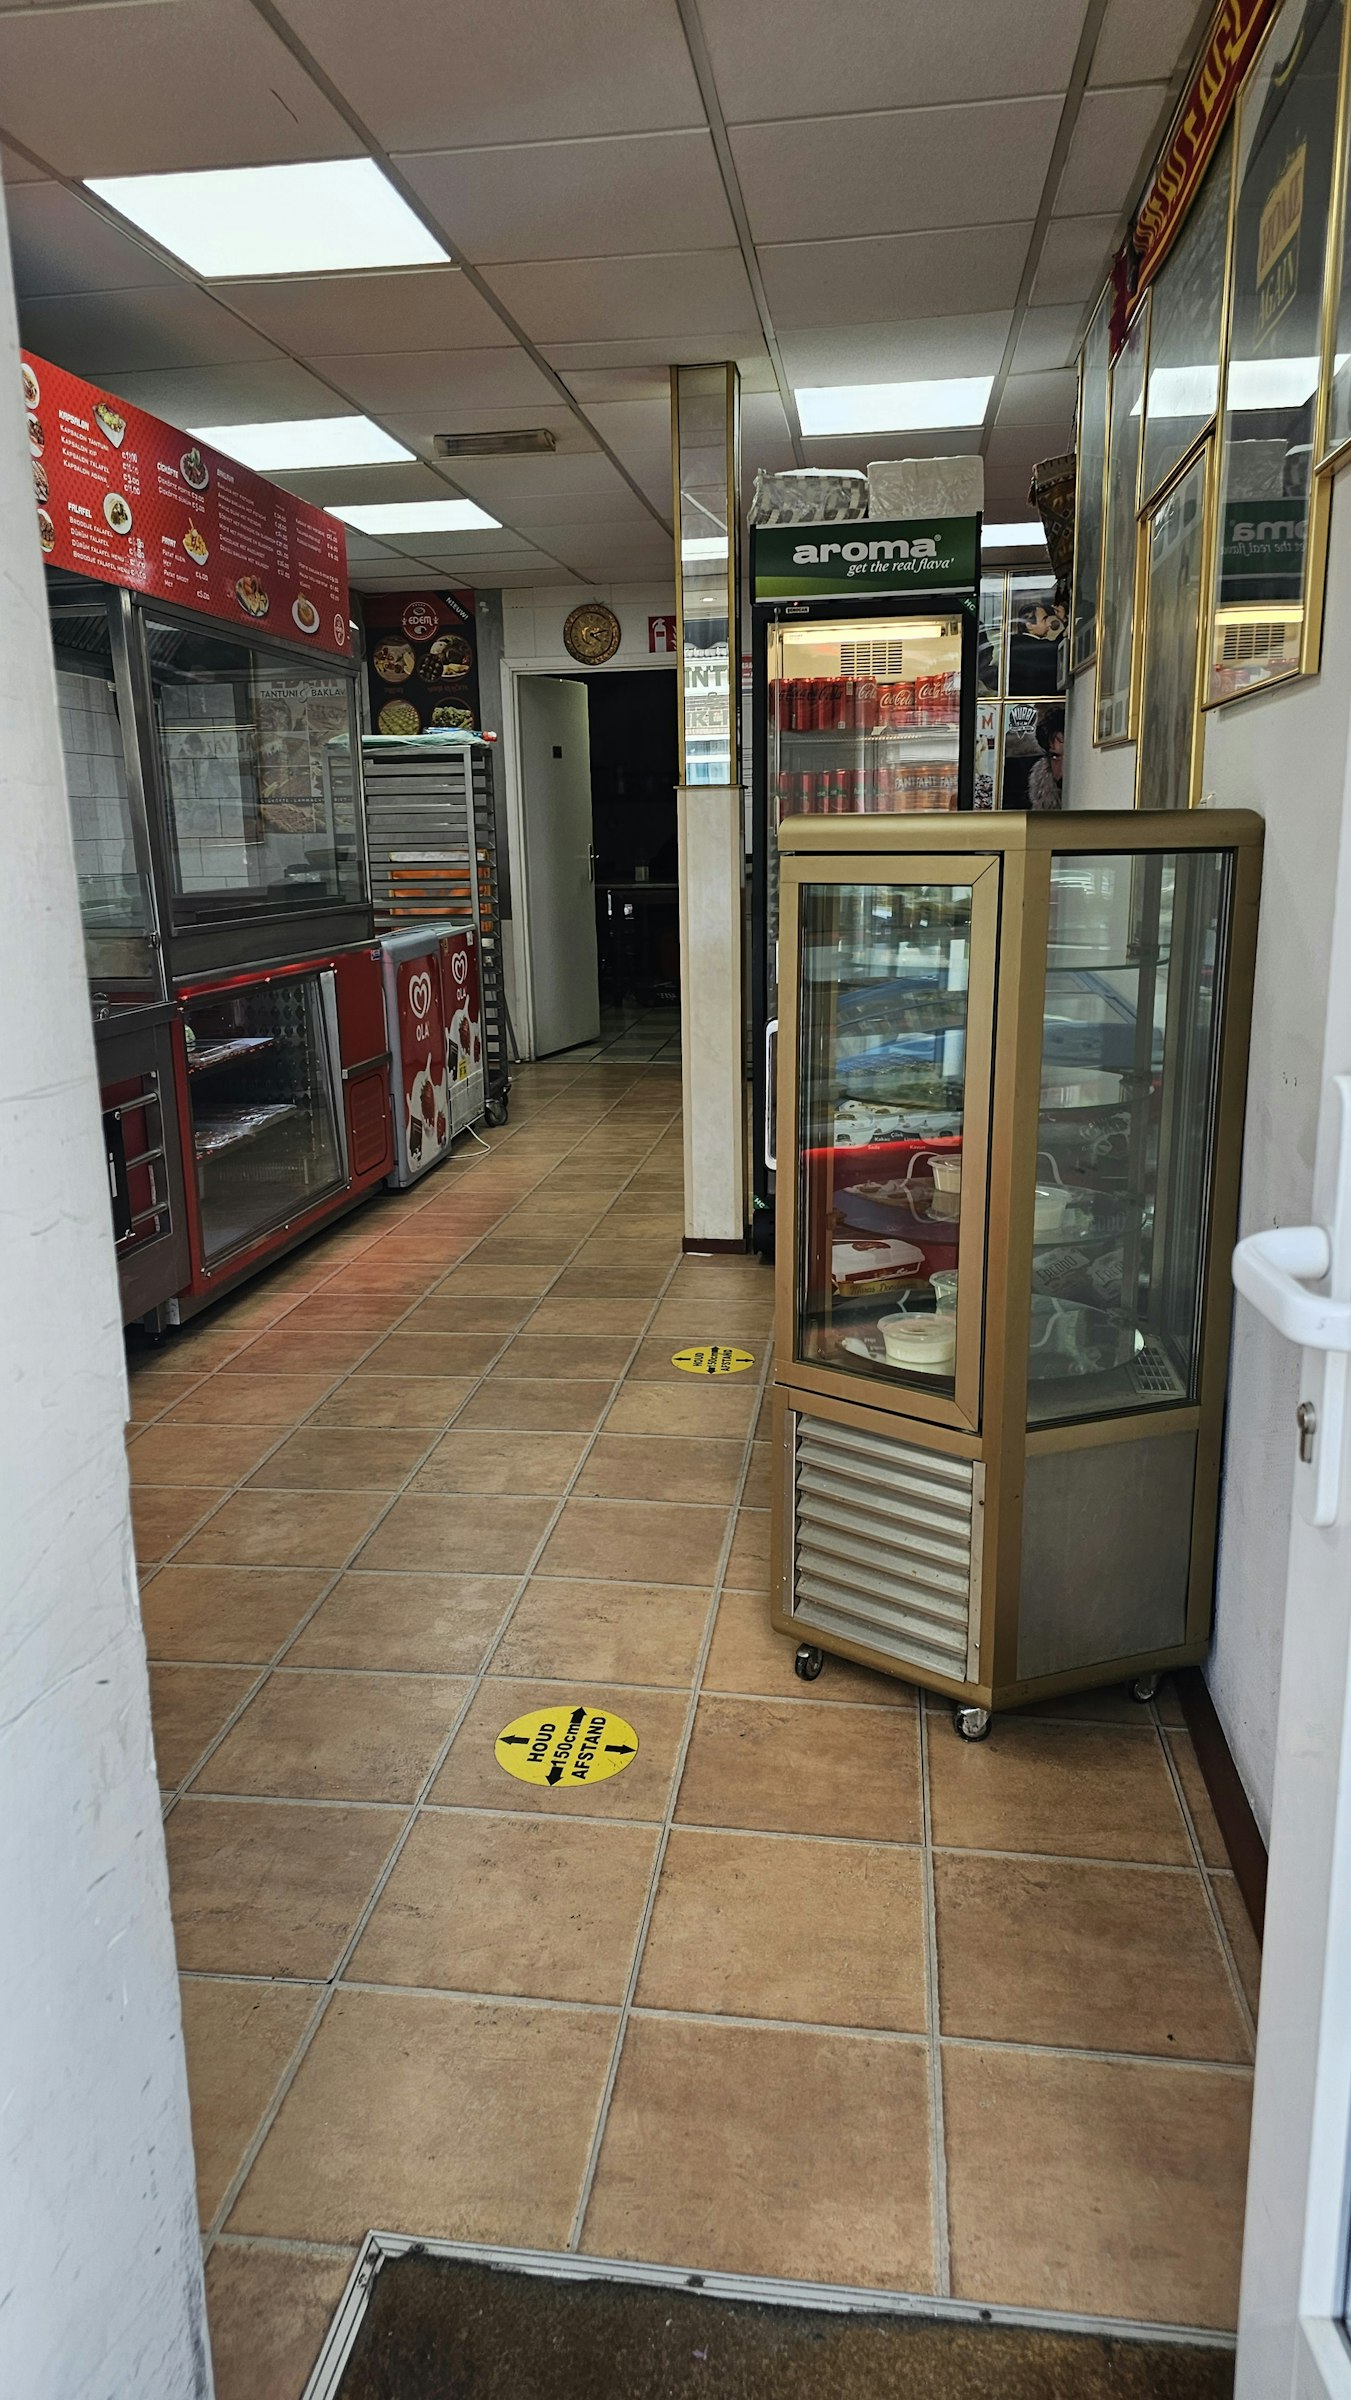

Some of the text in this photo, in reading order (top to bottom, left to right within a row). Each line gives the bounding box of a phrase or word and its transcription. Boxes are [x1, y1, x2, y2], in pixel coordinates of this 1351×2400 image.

[59, 409, 90, 432] KAPSALON
[60, 424, 87, 441] KAPSALON
[61, 436, 88, 453] KAPSALON
[62, 447, 89, 465] KAPSALON
[89, 460, 110, 474] FALAFEL
[63, 459, 90, 476] KAPSALON
[67, 501, 93, 519] FALAFEL
[93, 525, 114, 538] FALAFEL
[90, 535, 110, 547] FALAFEL
[91, 546, 111, 558] FALAFEL
[793, 537, 937, 565] aroma
[97, 559, 116, 571] FALAFEL
[847, 562, 867, 577] get
[870, 561, 889, 573] the
[892, 559, 915, 572] real
[446, 597, 470, 620] NIEUW!
[963, 598, 977, 612] HC
[408, 615, 434, 627] EDEM
[260, 690, 298, 698] TANTUNI
[457, 987, 467, 1001] OLA
[416, 1022, 430, 1042] OLA
[693, 1352, 704, 1367] HOUD
[721, 1349, 732, 1372] AFSTAND
[526, 1723, 556, 1763] HOUD
[550, 1722, 581, 1767] 150cm
[571, 1716, 606, 1779] AFSTAND
